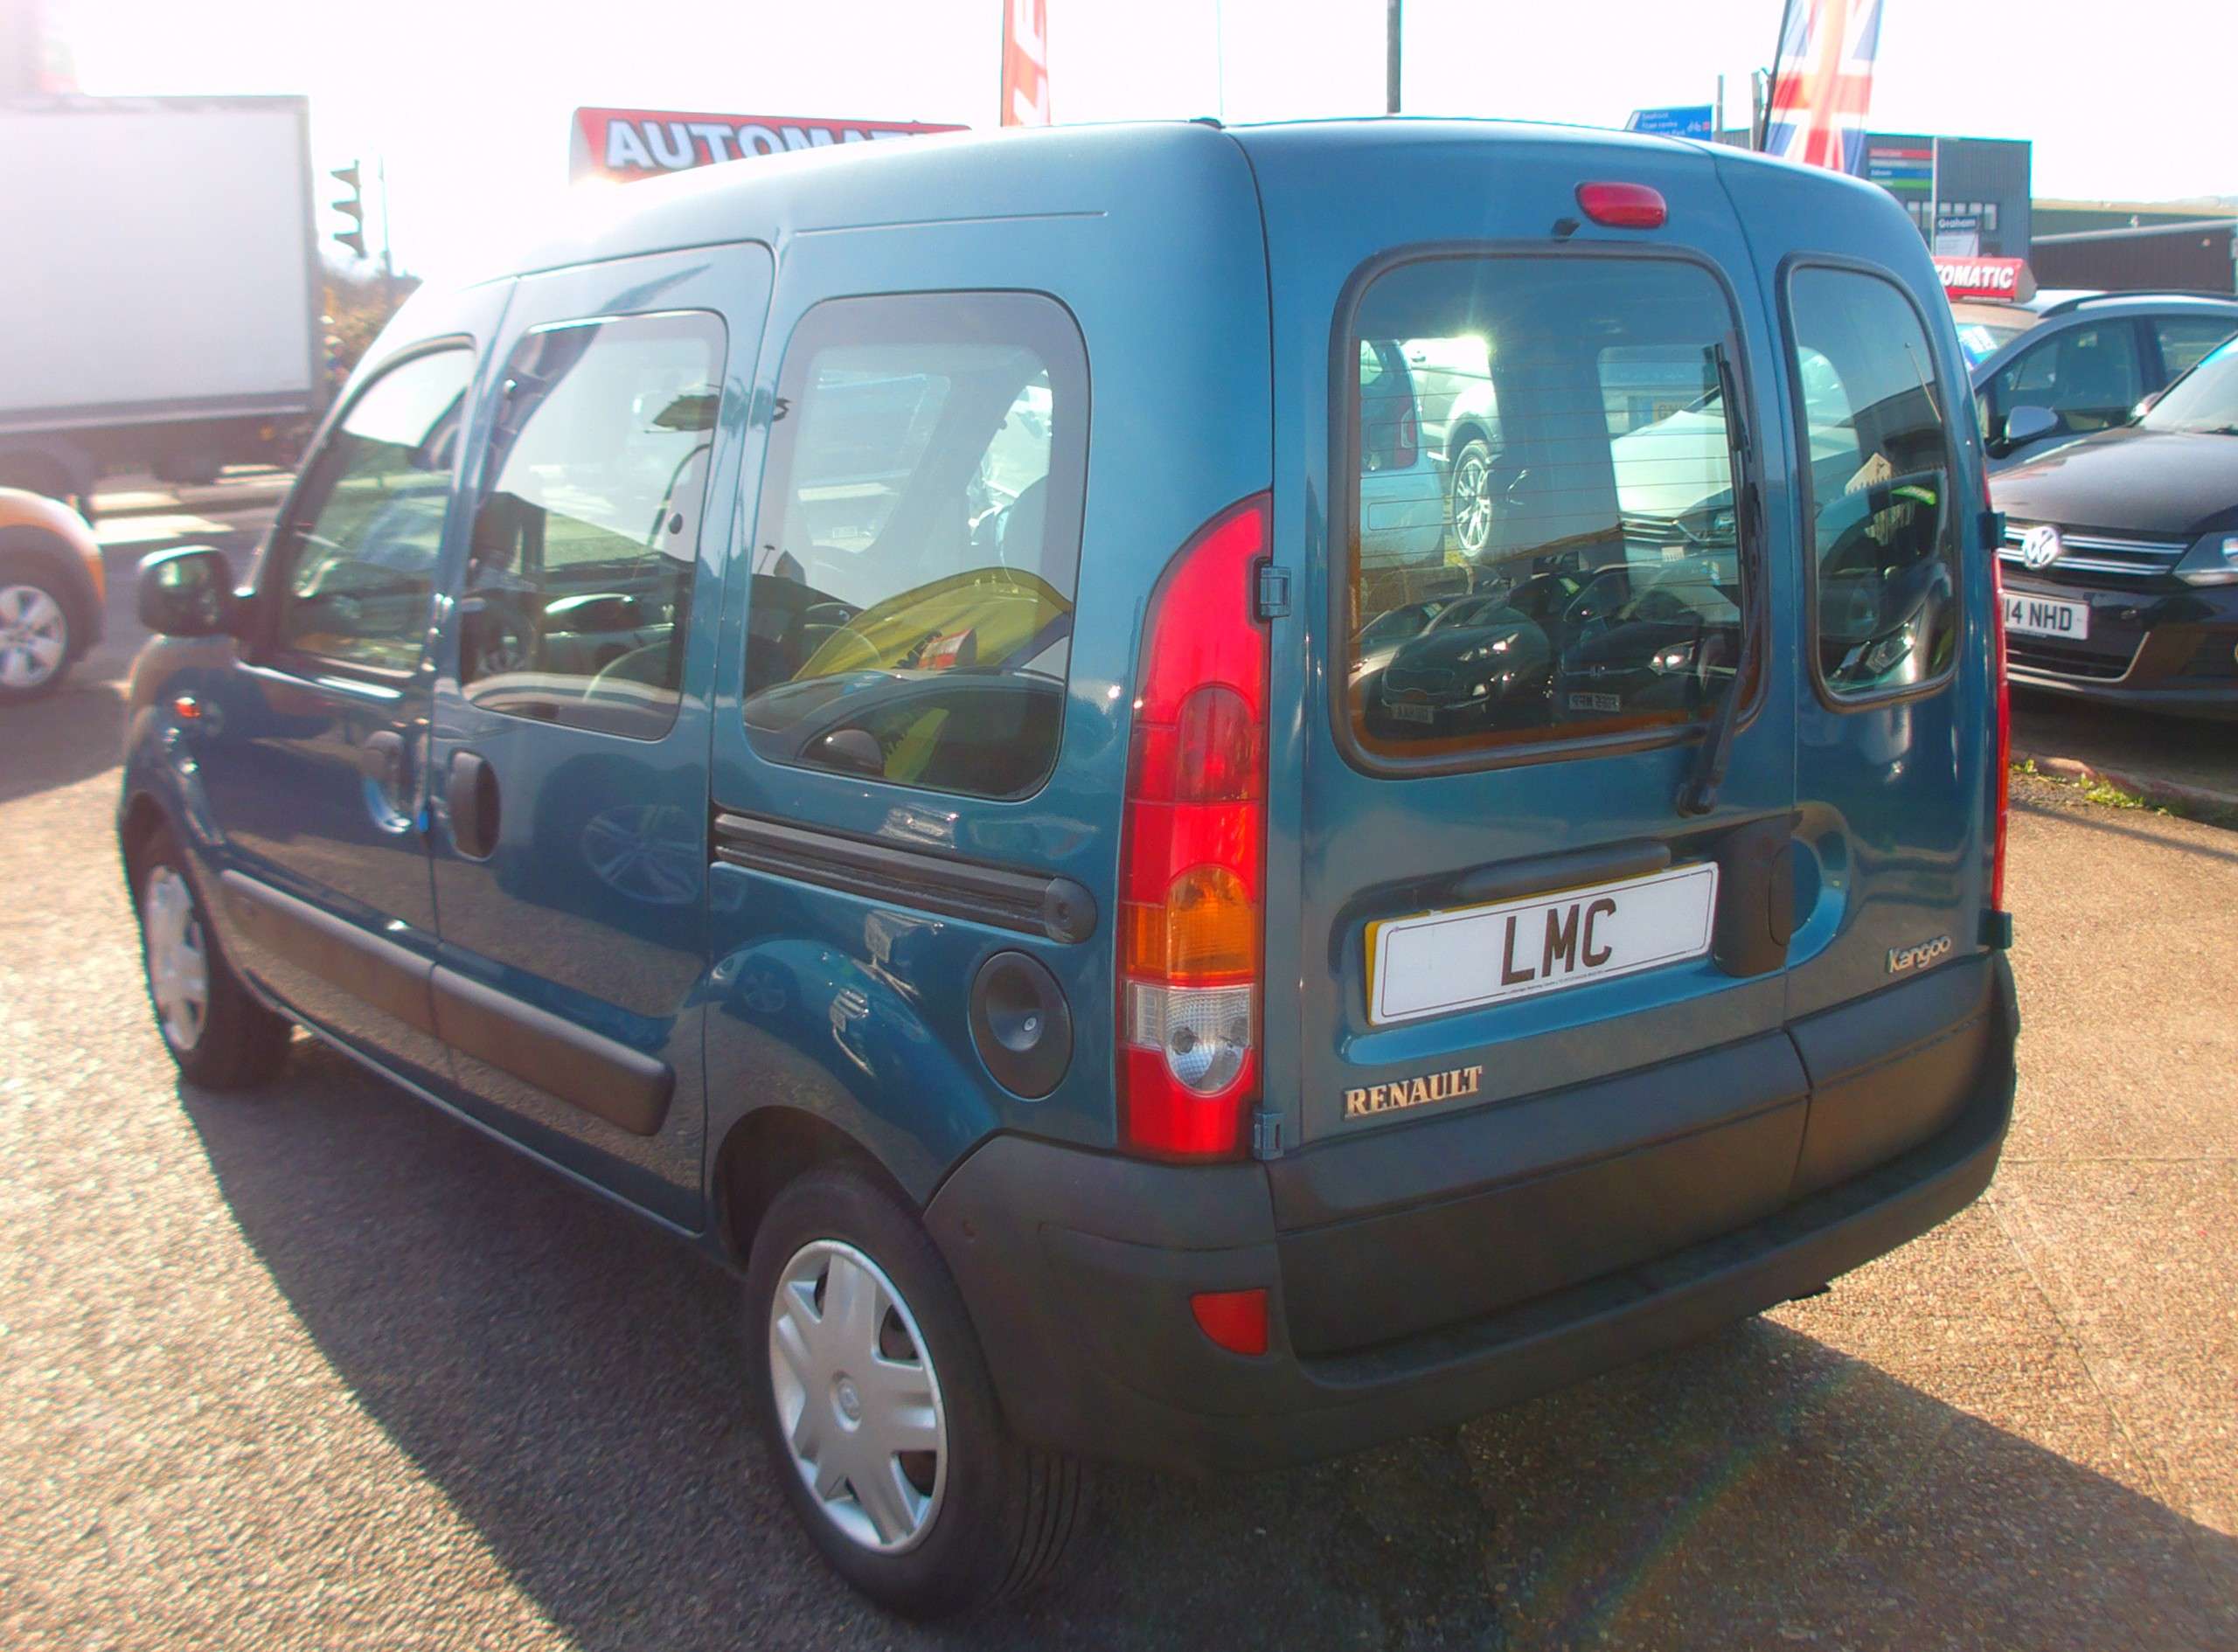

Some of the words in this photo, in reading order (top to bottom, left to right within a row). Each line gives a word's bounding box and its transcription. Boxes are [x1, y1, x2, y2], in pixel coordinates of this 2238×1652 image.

[2029, 602, 2072, 631] NHD
[1501, 898, 1616, 986] LMC
[1887, 935, 1952, 974] Kangoo
[1344, 1065, 1483, 1119] RENAULT
